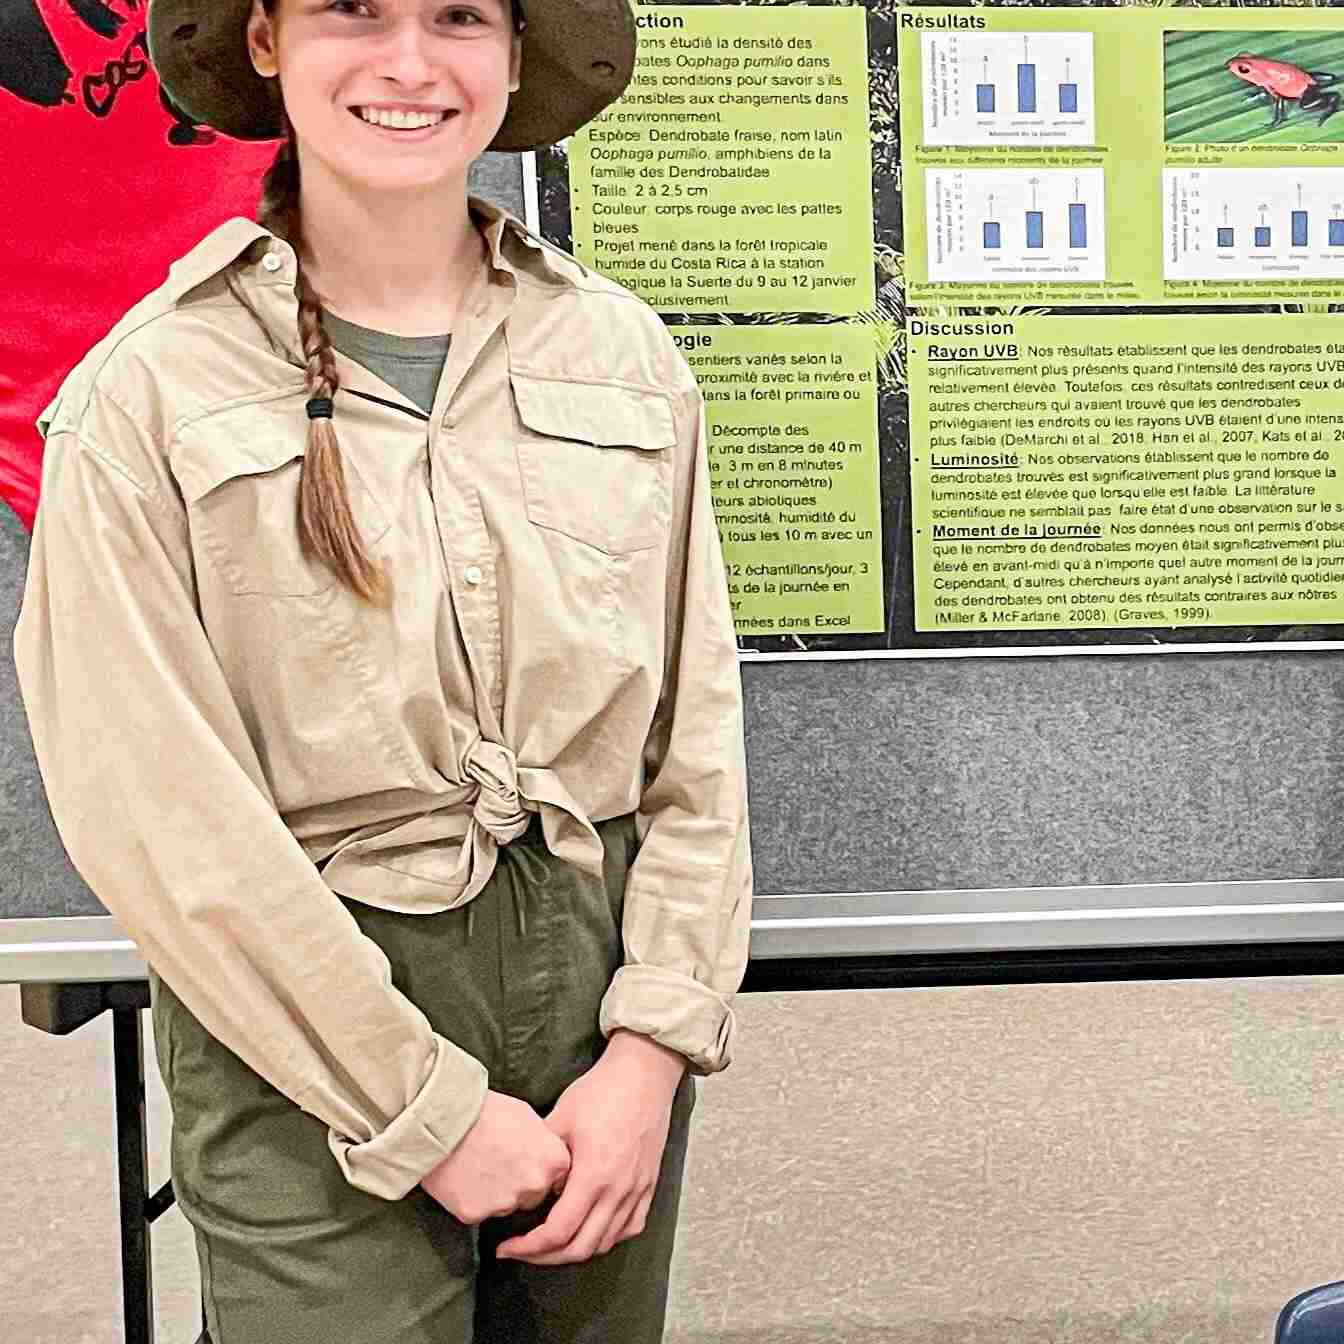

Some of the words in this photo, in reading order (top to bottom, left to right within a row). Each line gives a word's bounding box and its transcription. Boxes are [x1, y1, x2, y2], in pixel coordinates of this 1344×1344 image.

[901, 13, 986, 29] Résultats
[671, 36, 712, 48] étudié
[716, 36, 729, 48] la
[733, 36, 783, 48] densité
[787, 36, 812, 48] des
[676, 55, 740, 70] Oophaga
[743, 55, 794, 70] pumilio
[796, 55, 831, 67] dans
[662, 74, 733, 86] conditions
[736, 76, 767, 89] pour
[770, 74, 813, 86] savoir
[817, 74, 844, 86] s'ils
[621, 92, 686, 104] sensibles
[689, 94, 714, 104] aux
[718, 92, 812, 107] changements
[815, 92, 849, 104] dans
[655, 205, 693, 218] corps
[696, 205, 737, 218] rouge
[740, 205, 774, 215] avec
[776, 203, 797, 215] les
[801, 203, 843, 218] pattes
[593, 221, 639, 234] bleues
[594, 239, 635, 254] Projet
[637, 239, 678, 251] mené
[681, 239, 716, 251] dans
[718, 239, 731, 251] la
[735, 239, 766, 251] forêt
[770, 239, 828, 254] tropicale
[595, 257, 646, 269] humide
[649, 257, 668, 269] du
[670, 257, 714, 269] Costa
[713, 257, 746, 269] Rica
[750, 257, 760, 269] à
[763, 257, 776, 269] la
[779, 257, 825, 269] station
[670, 275, 682, 288] la
[686, 275, 732, 288] Suerte
[735, 275, 754, 288] du
[757, 275, 766, 288] 9
[770, 277, 787, 288] au
[791, 275, 808, 288] 12
[812, 275, 857, 290] janvier
[911, 321, 1014, 336] Discussion
[928, 345, 978, 359] Rayon
[1028, 345, 1054, 357] Nos
[1057, 344, 1114, 357] résultats
[1117, 344, 1187, 356] établissent
[1191, 346, 1216, 359] que
[1219, 344, 1238, 356] les
[1241, 343, 1322, 356] dendrobates
[688, 353, 744, 365] sentiers
[743, 353, 786, 365] variés
[790, 353, 827, 365] selon
[830, 353, 842, 365] la
[928, 363, 1038, 378] significativement
[1041, 363, 1068, 378] plus
[1072, 362, 1129, 377] présents
[1133, 362, 1174, 377] quand
[1176, 362, 1238, 374] l'intensité
[1240, 361, 1267, 373] des
[1266, 363, 1313, 376] rayons
[713, 424, 781, 439] Décompte
[784, 424, 809, 437] des
[1028, 453, 1054, 465] Nos
[1057, 452, 1140, 465] observations
[1144, 451, 1214, 464] établissent
[1217, 453, 1242, 466] que
[1245, 450, 1257, 463] le
[1260, 450, 1310, 462] nombre
[1312, 450, 1329, 462] de
[933, 526, 995, 537] Moment
[1001, 525, 1020, 536] de
[1024, 524, 1038, 535] la
[1111, 522, 1137, 534] Nos
[1139, 522, 1195, 534] données
[1198, 523, 1230, 533] nous
[1233, 521, 1254, 533] ont
[1257, 520, 1302, 535] permis
[779, 615, 810, 628] dans
[814, 615, 850, 627] Excel
